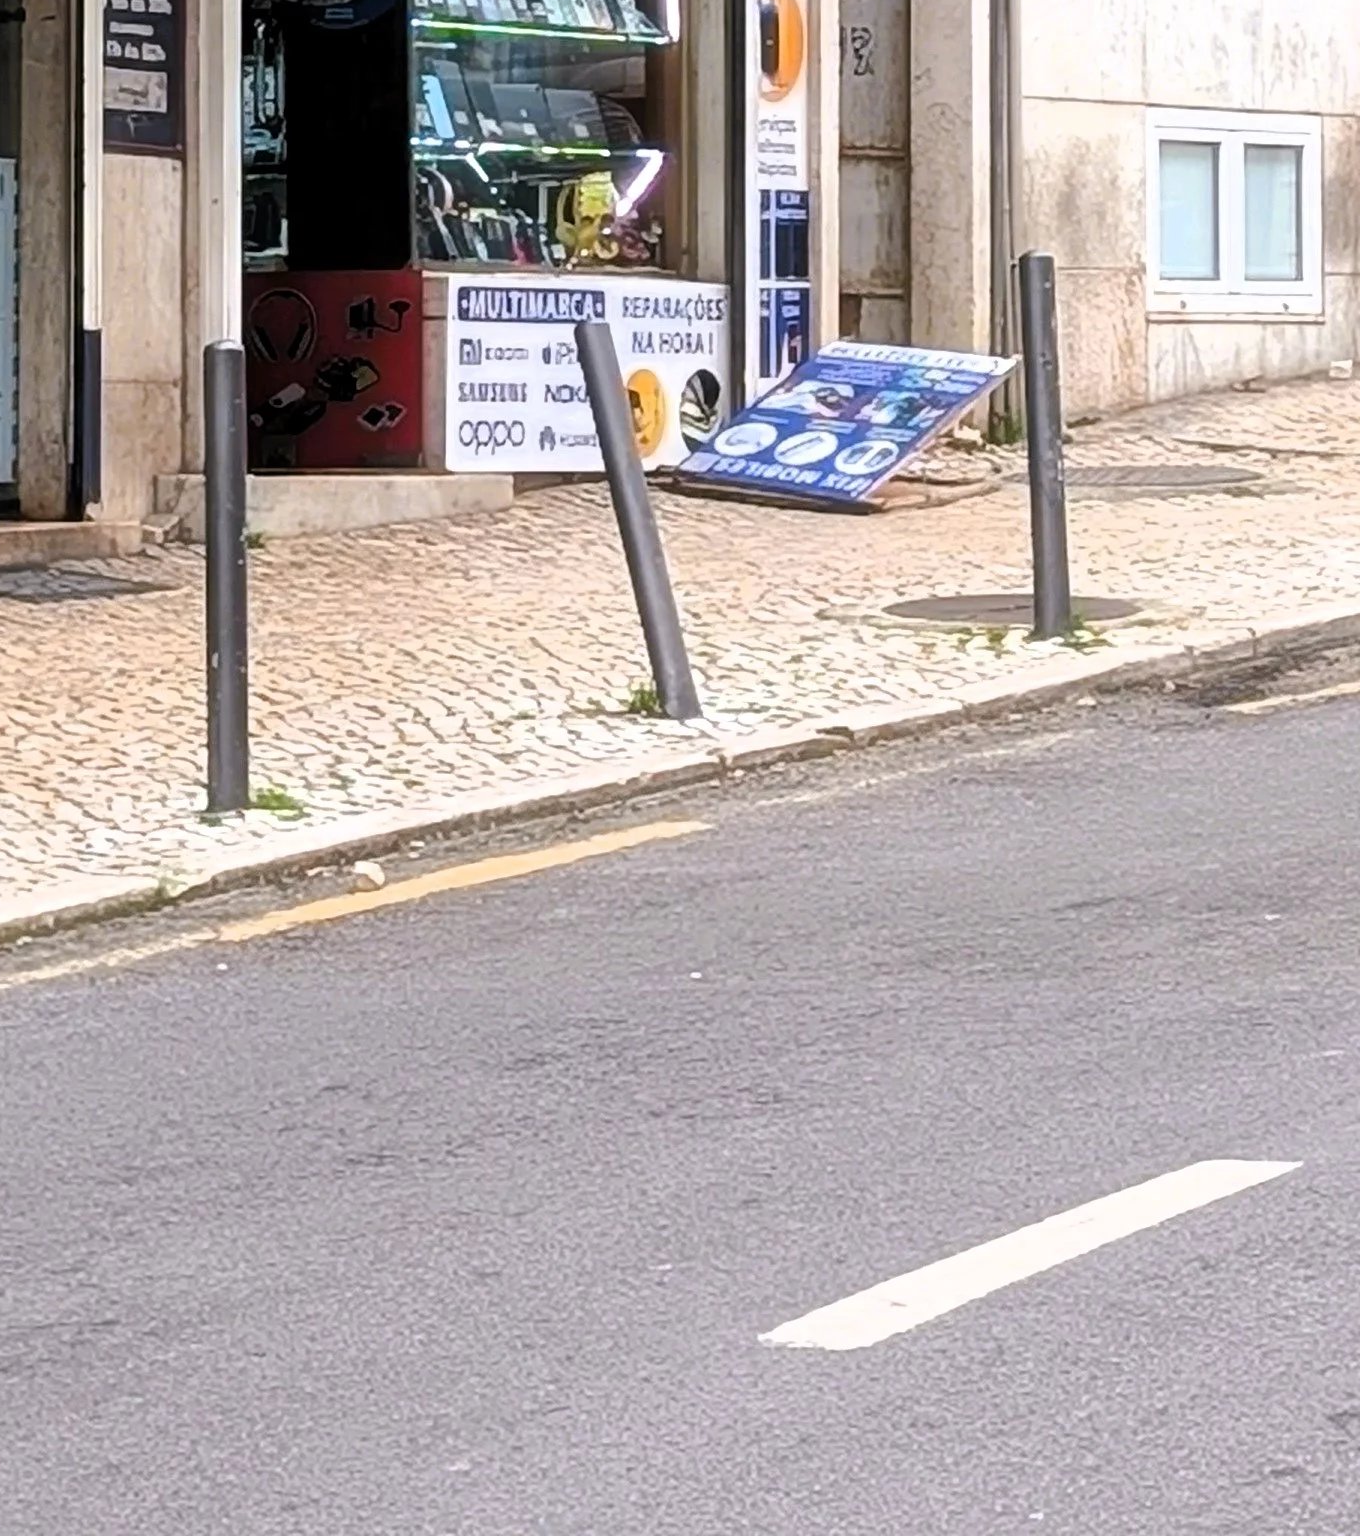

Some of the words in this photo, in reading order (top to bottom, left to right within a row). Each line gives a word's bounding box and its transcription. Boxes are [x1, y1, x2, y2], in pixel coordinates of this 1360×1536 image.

[468, 289, 595, 321] MULTIMARCA
[621, 293, 725, 327] REPARAÇÕES
[631, 333, 655, 355] NA
